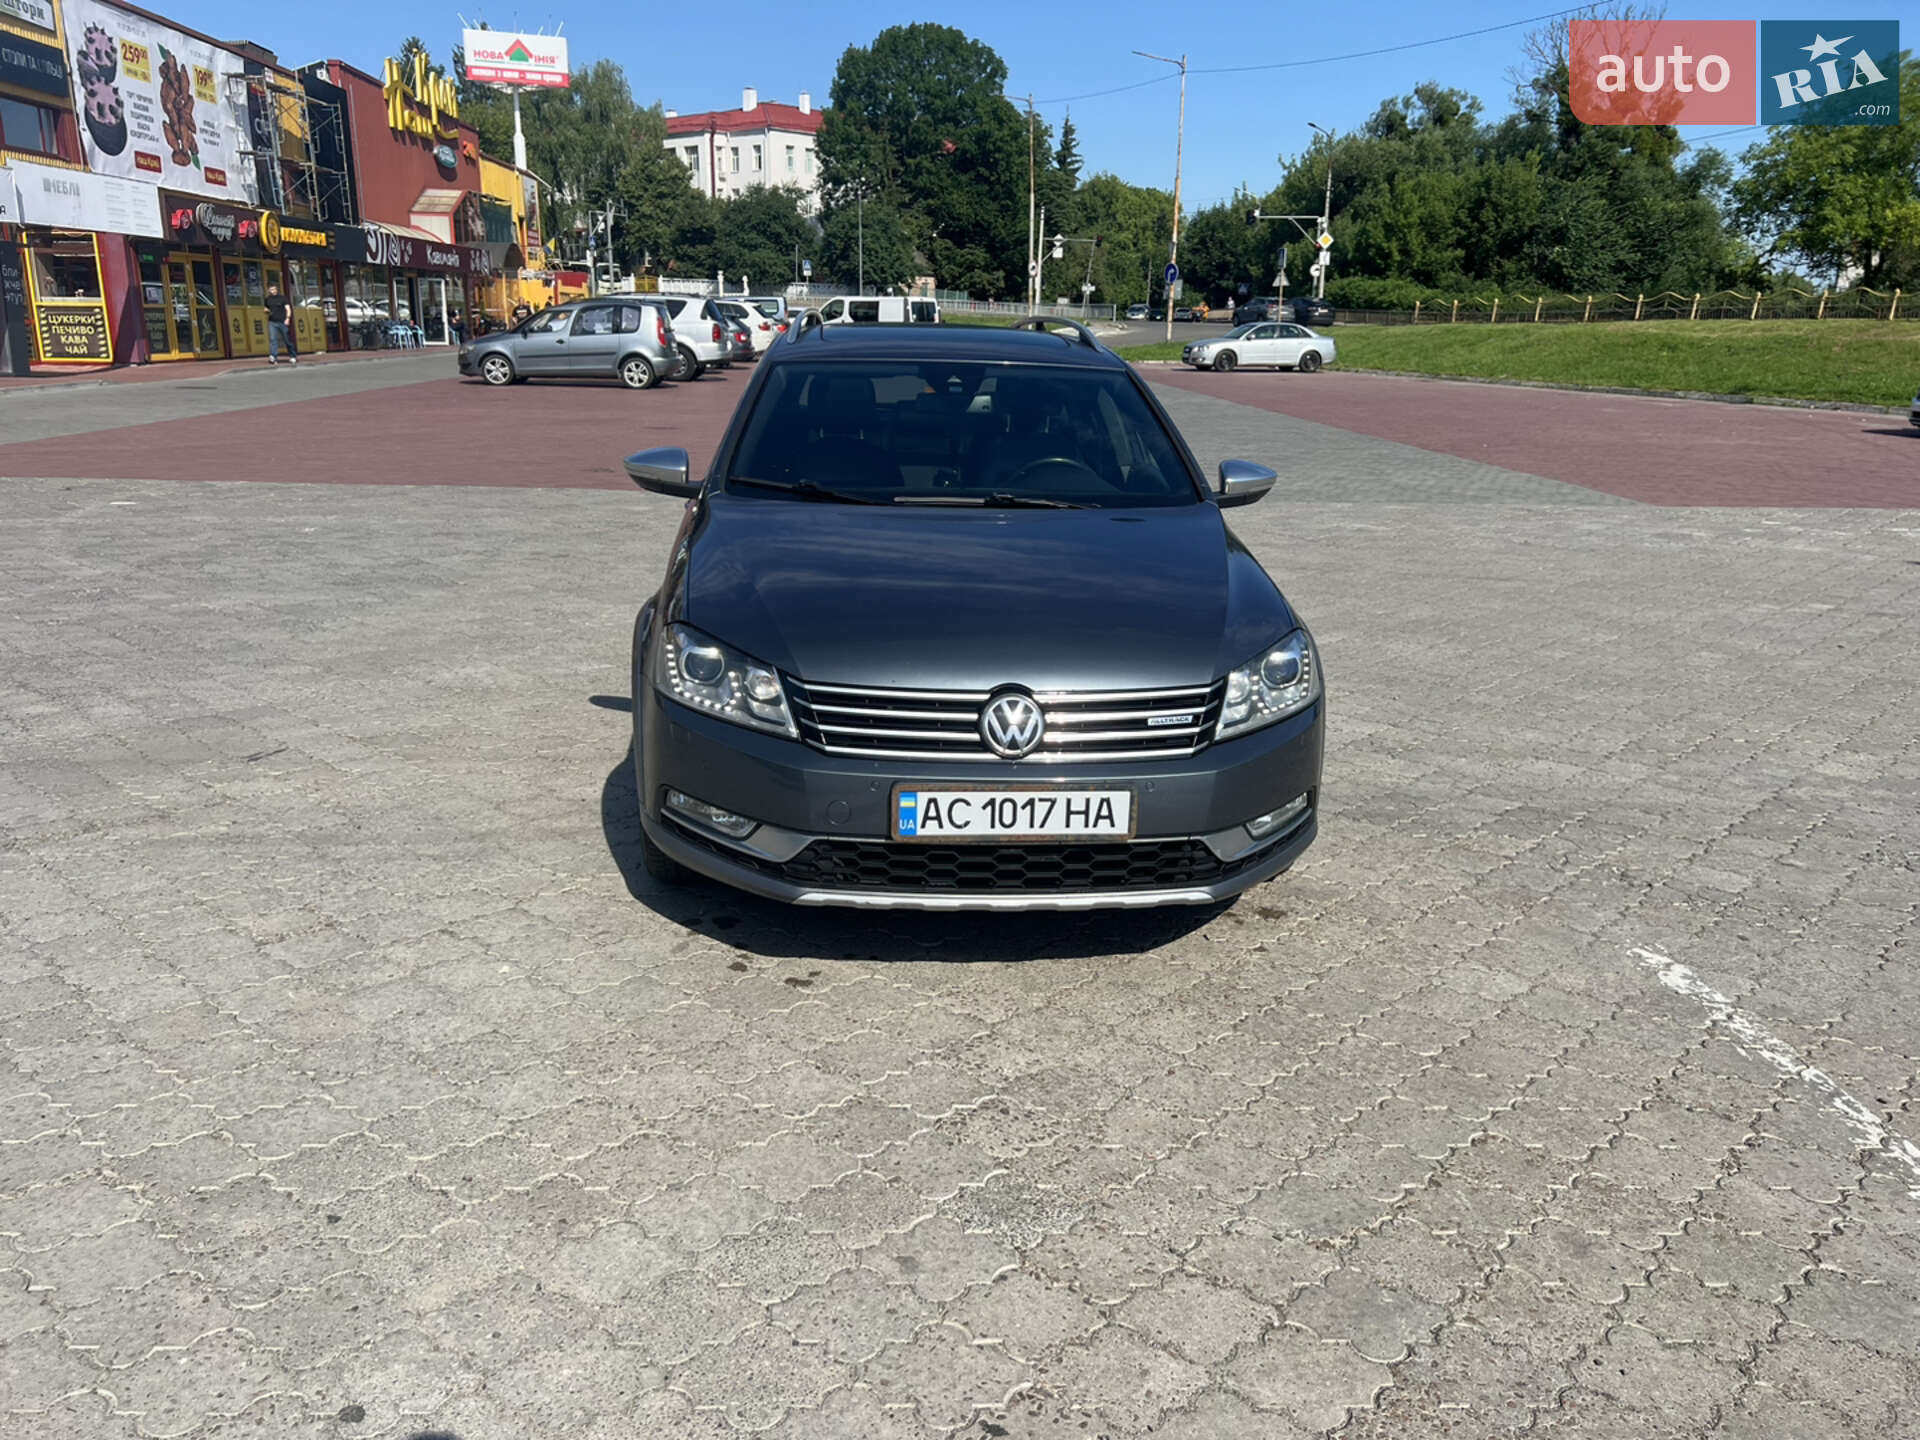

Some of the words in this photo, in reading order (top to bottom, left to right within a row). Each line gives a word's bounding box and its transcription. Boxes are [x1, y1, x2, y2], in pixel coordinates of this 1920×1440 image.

[473, 50, 504, 60] НОВА
[48, 315, 95, 325] ЦУКЕРКИ
[52, 325, 94, 335] ПЕЧИВО
[60, 335, 88, 344] КАВА
[65, 344, 88, 354] ЧАЙ
[920, 798, 972, 829] AC
[981, 798, 1057, 829] 1017
[1065, 798, 1116, 829] HA
[899, 819, 915, 830] UA
